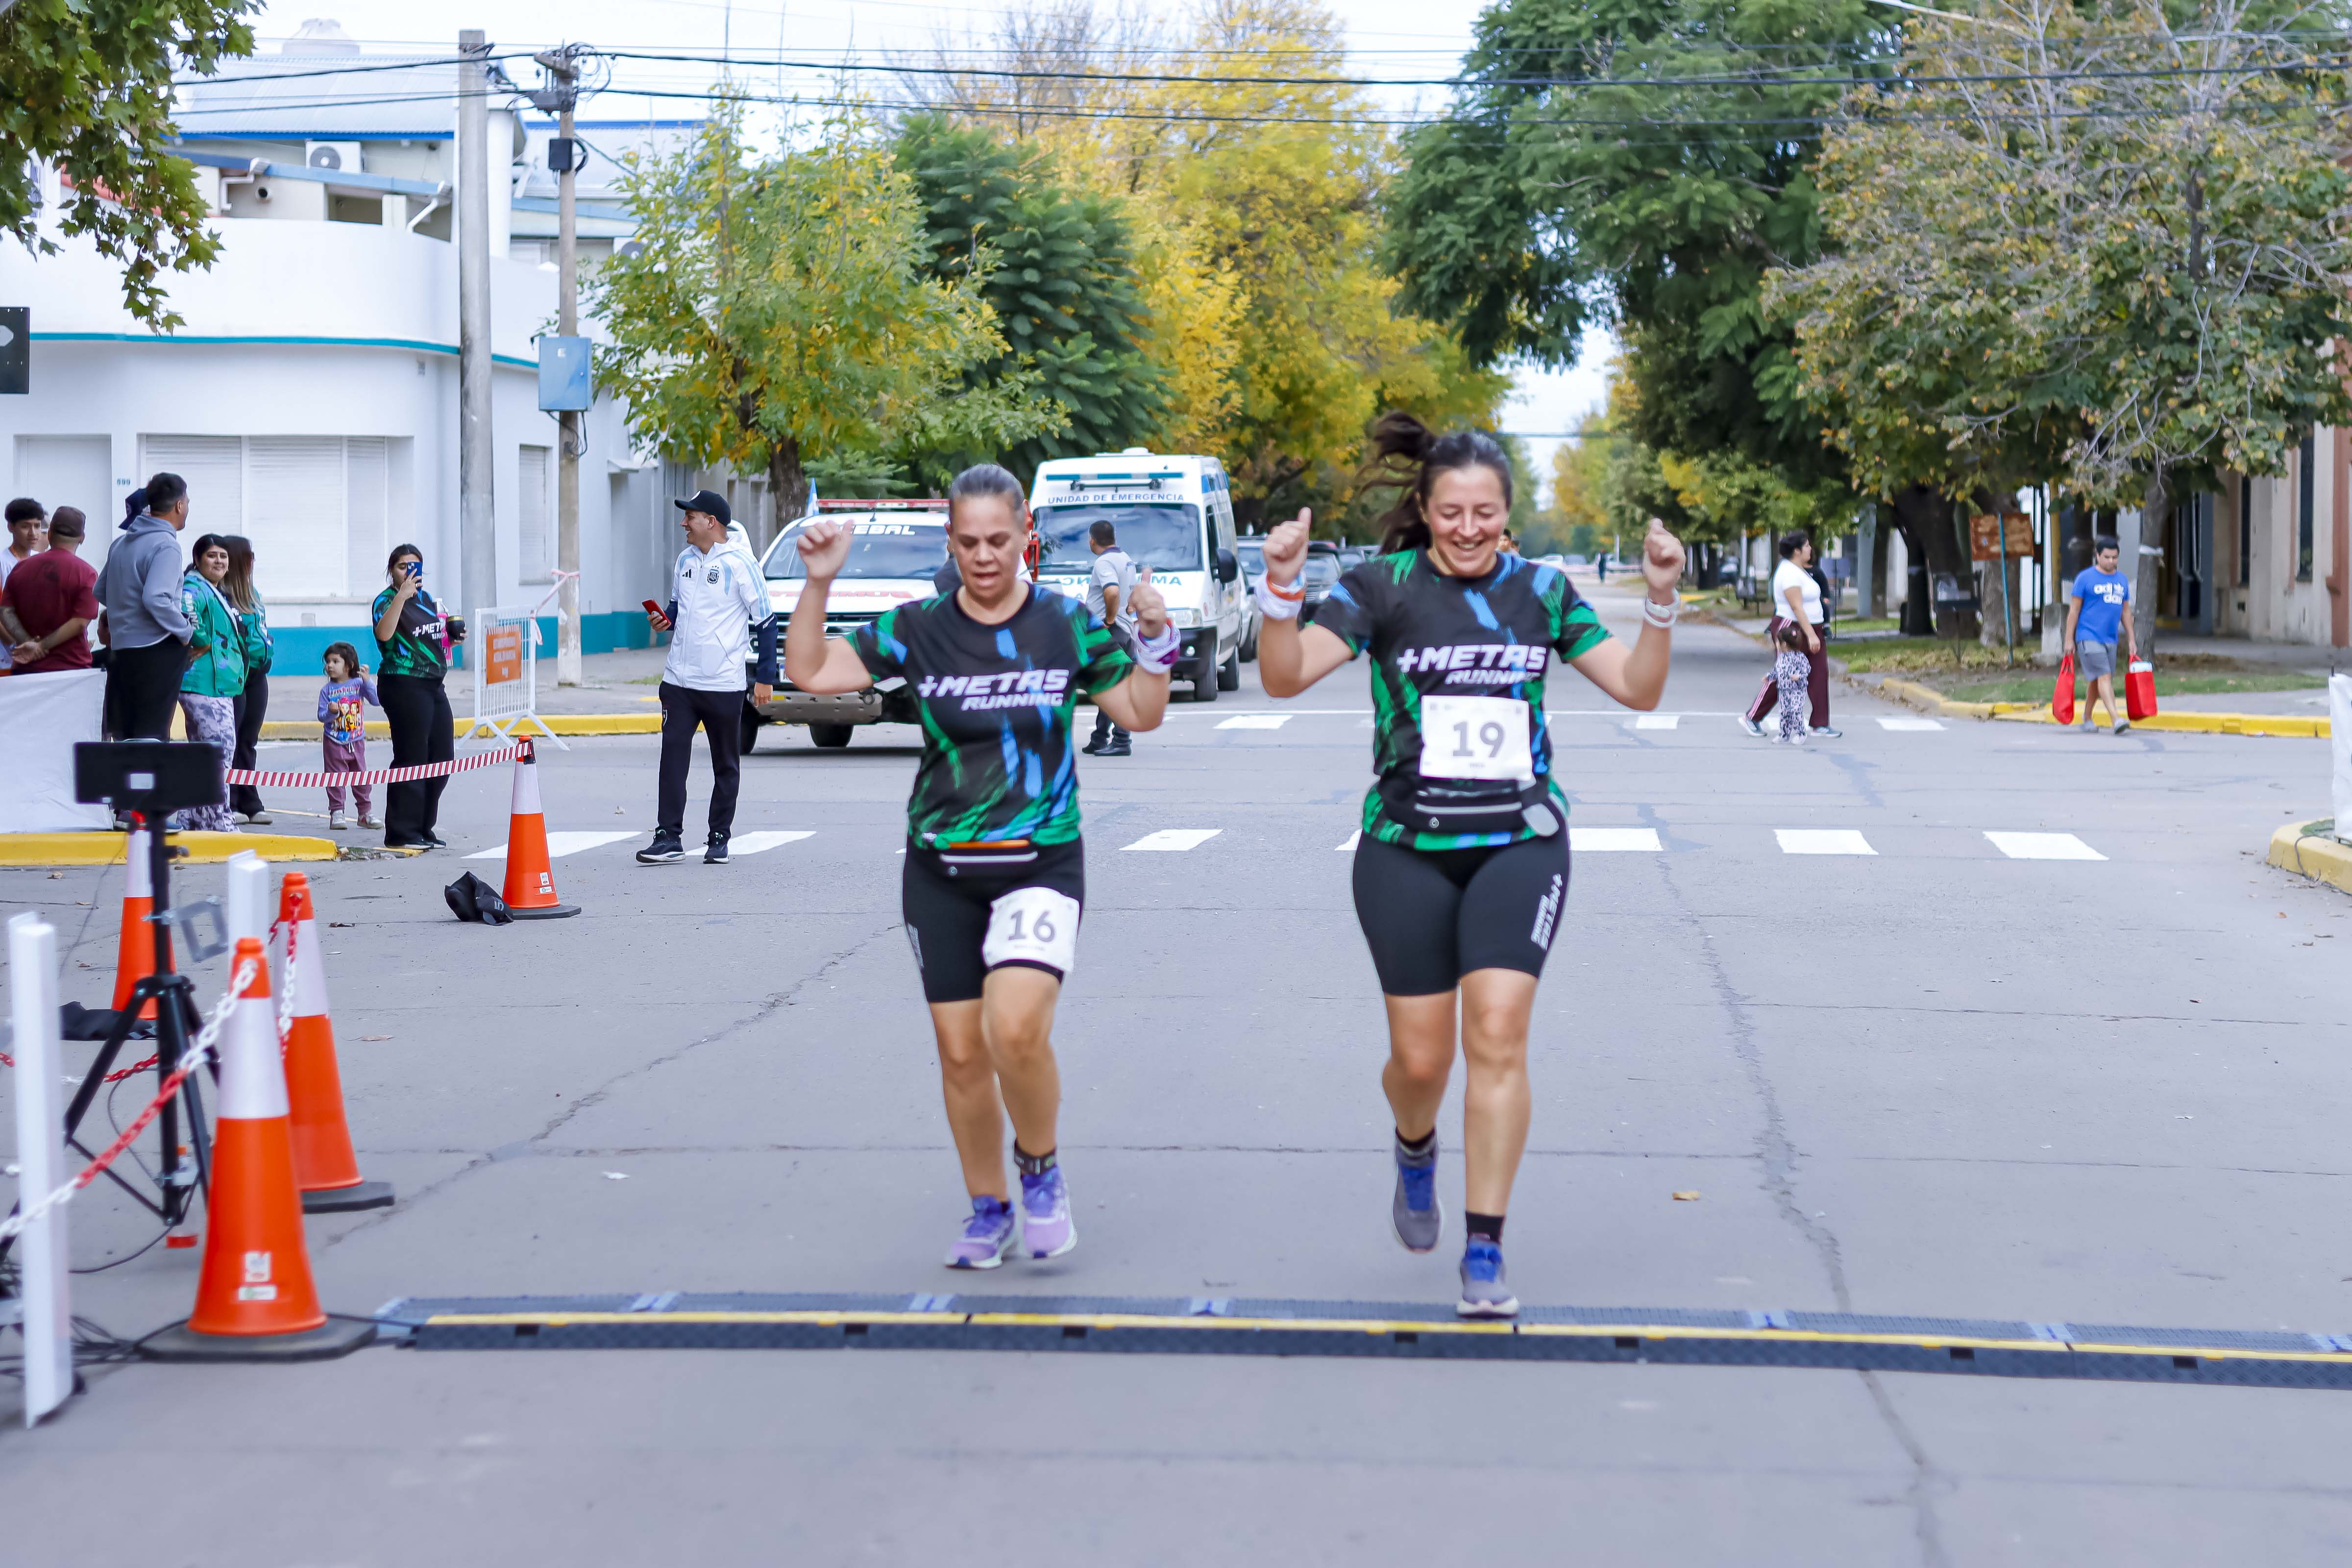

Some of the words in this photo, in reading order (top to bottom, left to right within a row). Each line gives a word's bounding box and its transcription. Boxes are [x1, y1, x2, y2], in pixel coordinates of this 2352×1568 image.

[1048, 495, 1089, 504] UNIDAD
[1111, 493, 1184, 502] EMERGENCIA
[849, 525, 916, 536] EBAL
[1396, 644, 1546, 673] +METAS
[918, 669, 1070, 698] +METAS
[960, 693, 1064, 711] RUNNING
[1452, 721, 1505, 758] 19
[1008, 909, 1055, 943] 16
